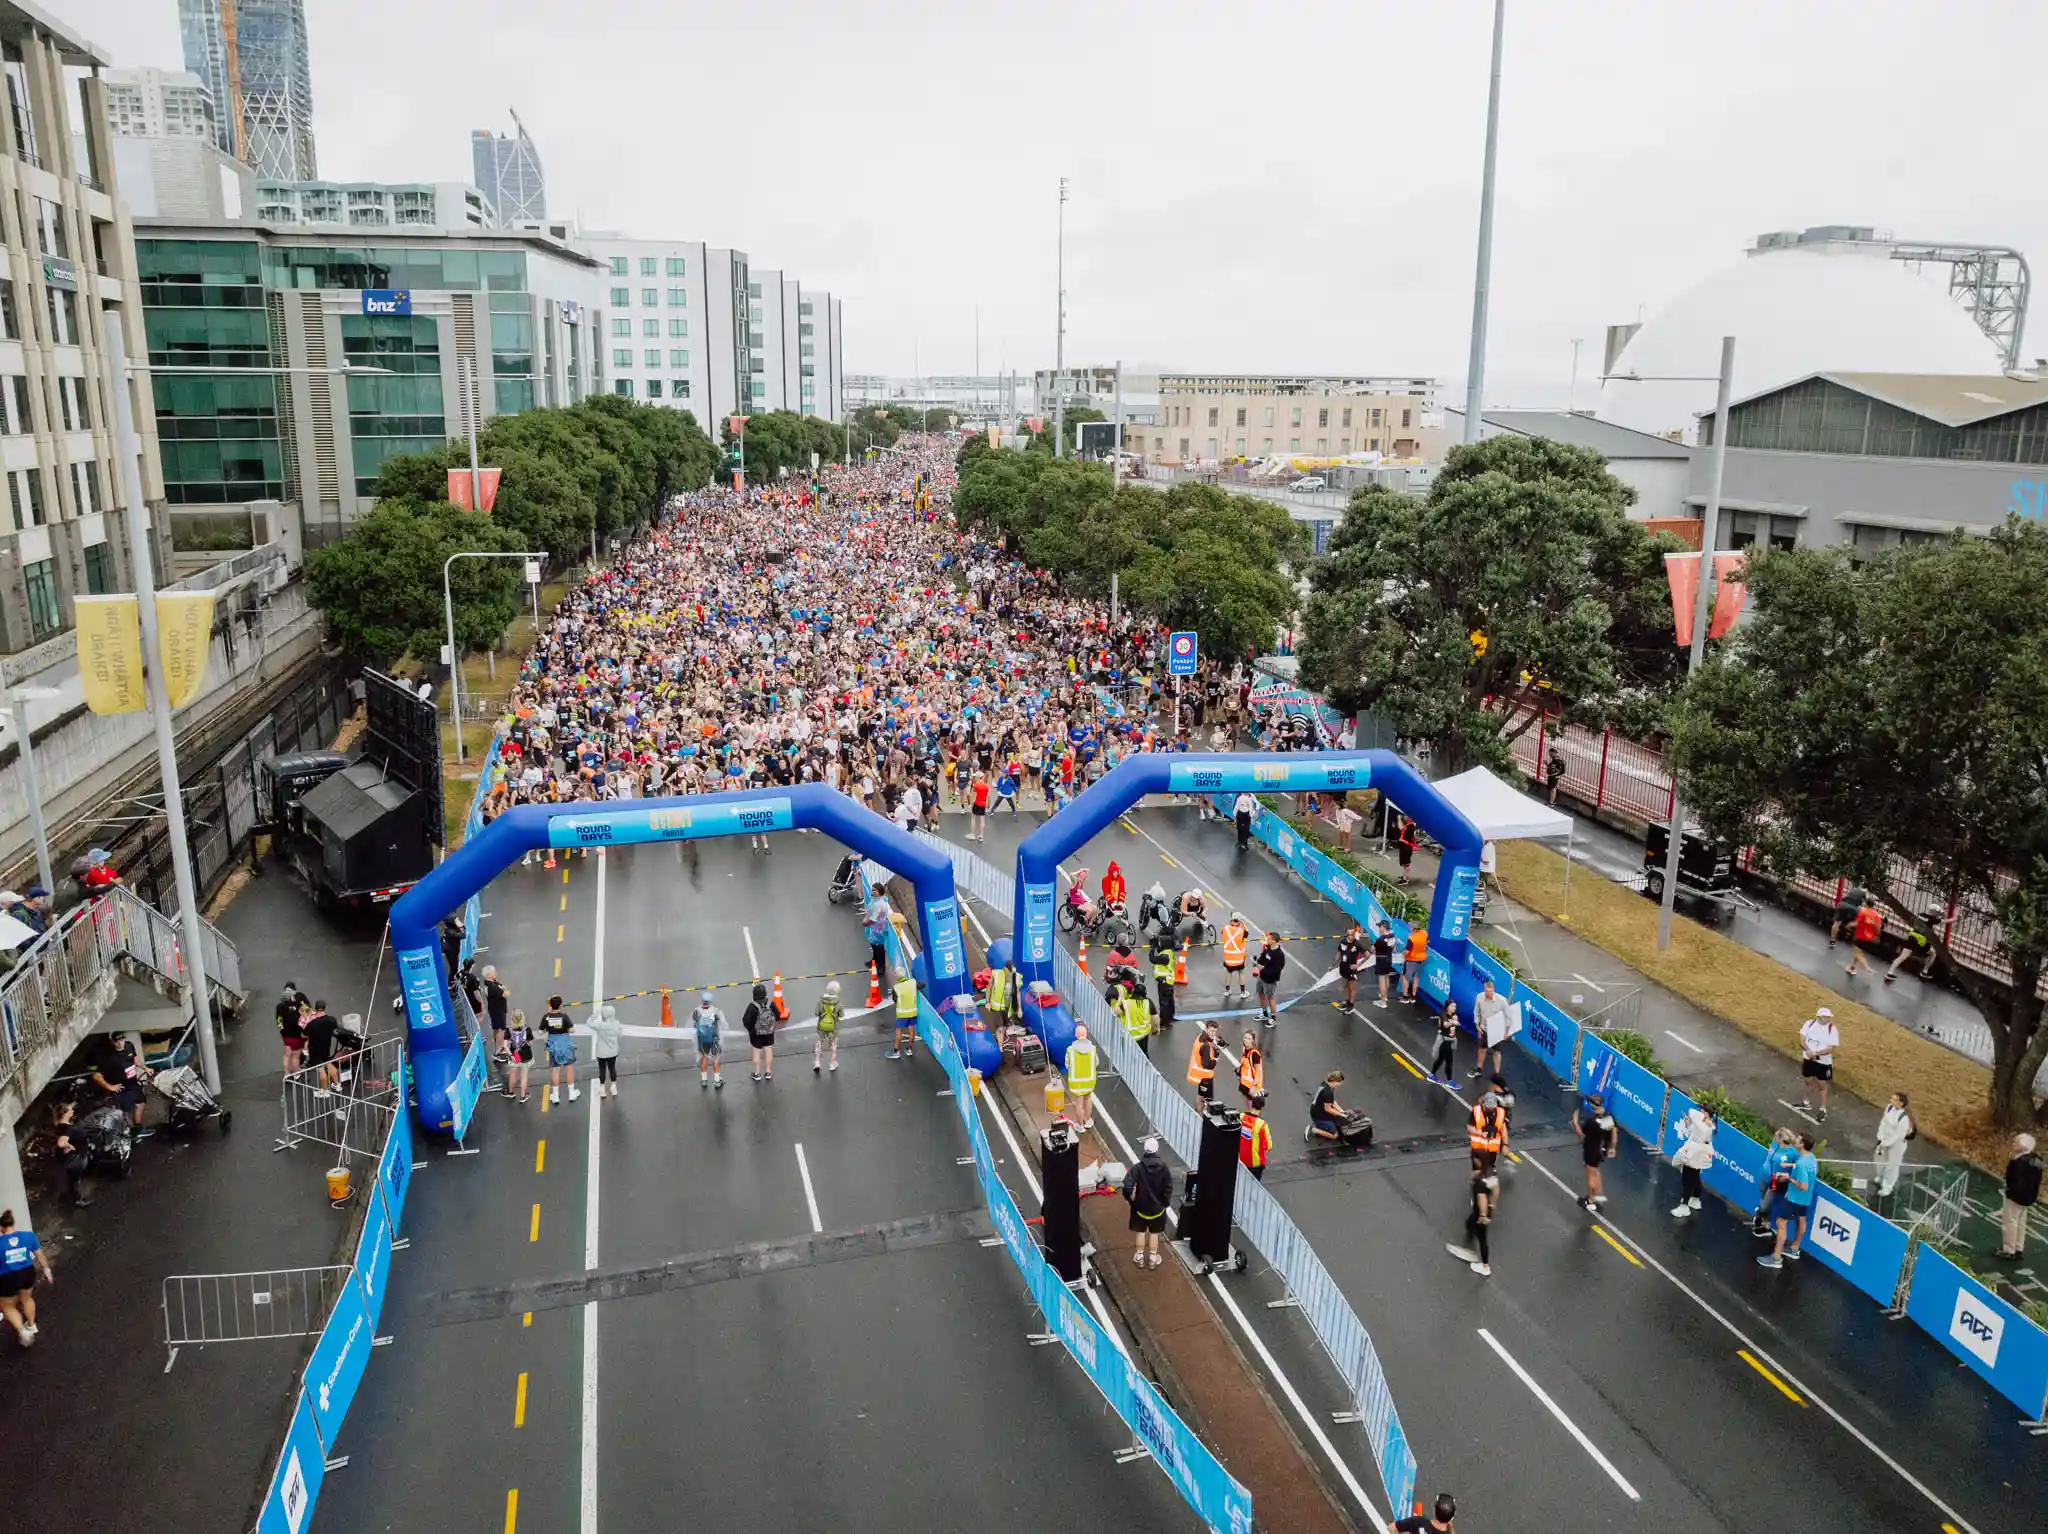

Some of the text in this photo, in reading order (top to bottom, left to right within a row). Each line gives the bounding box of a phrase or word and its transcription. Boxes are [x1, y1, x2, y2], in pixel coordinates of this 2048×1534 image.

[367, 297, 396, 312] bnz
[1193, 772, 1222, 780] ROUND
[1327, 769, 1356, 778] ROUND
[1195, 779, 1222, 787] BAYS
[1329, 776, 1355, 785] BAYS
[739, 810, 773, 821] ROUND
[743, 818, 774, 828] BAYS
[576, 824, 612, 835] ROUND
[580, 832, 613, 842] BAYS
[1529, 1013, 1557, 1043] ROUND
[1531, 1027, 1556, 1057] BAYS
[1633, 1094, 1654, 1115] Cross
[1729, 1160, 1755, 1184] Cross
[328, 1340, 352, 1389] Southern
